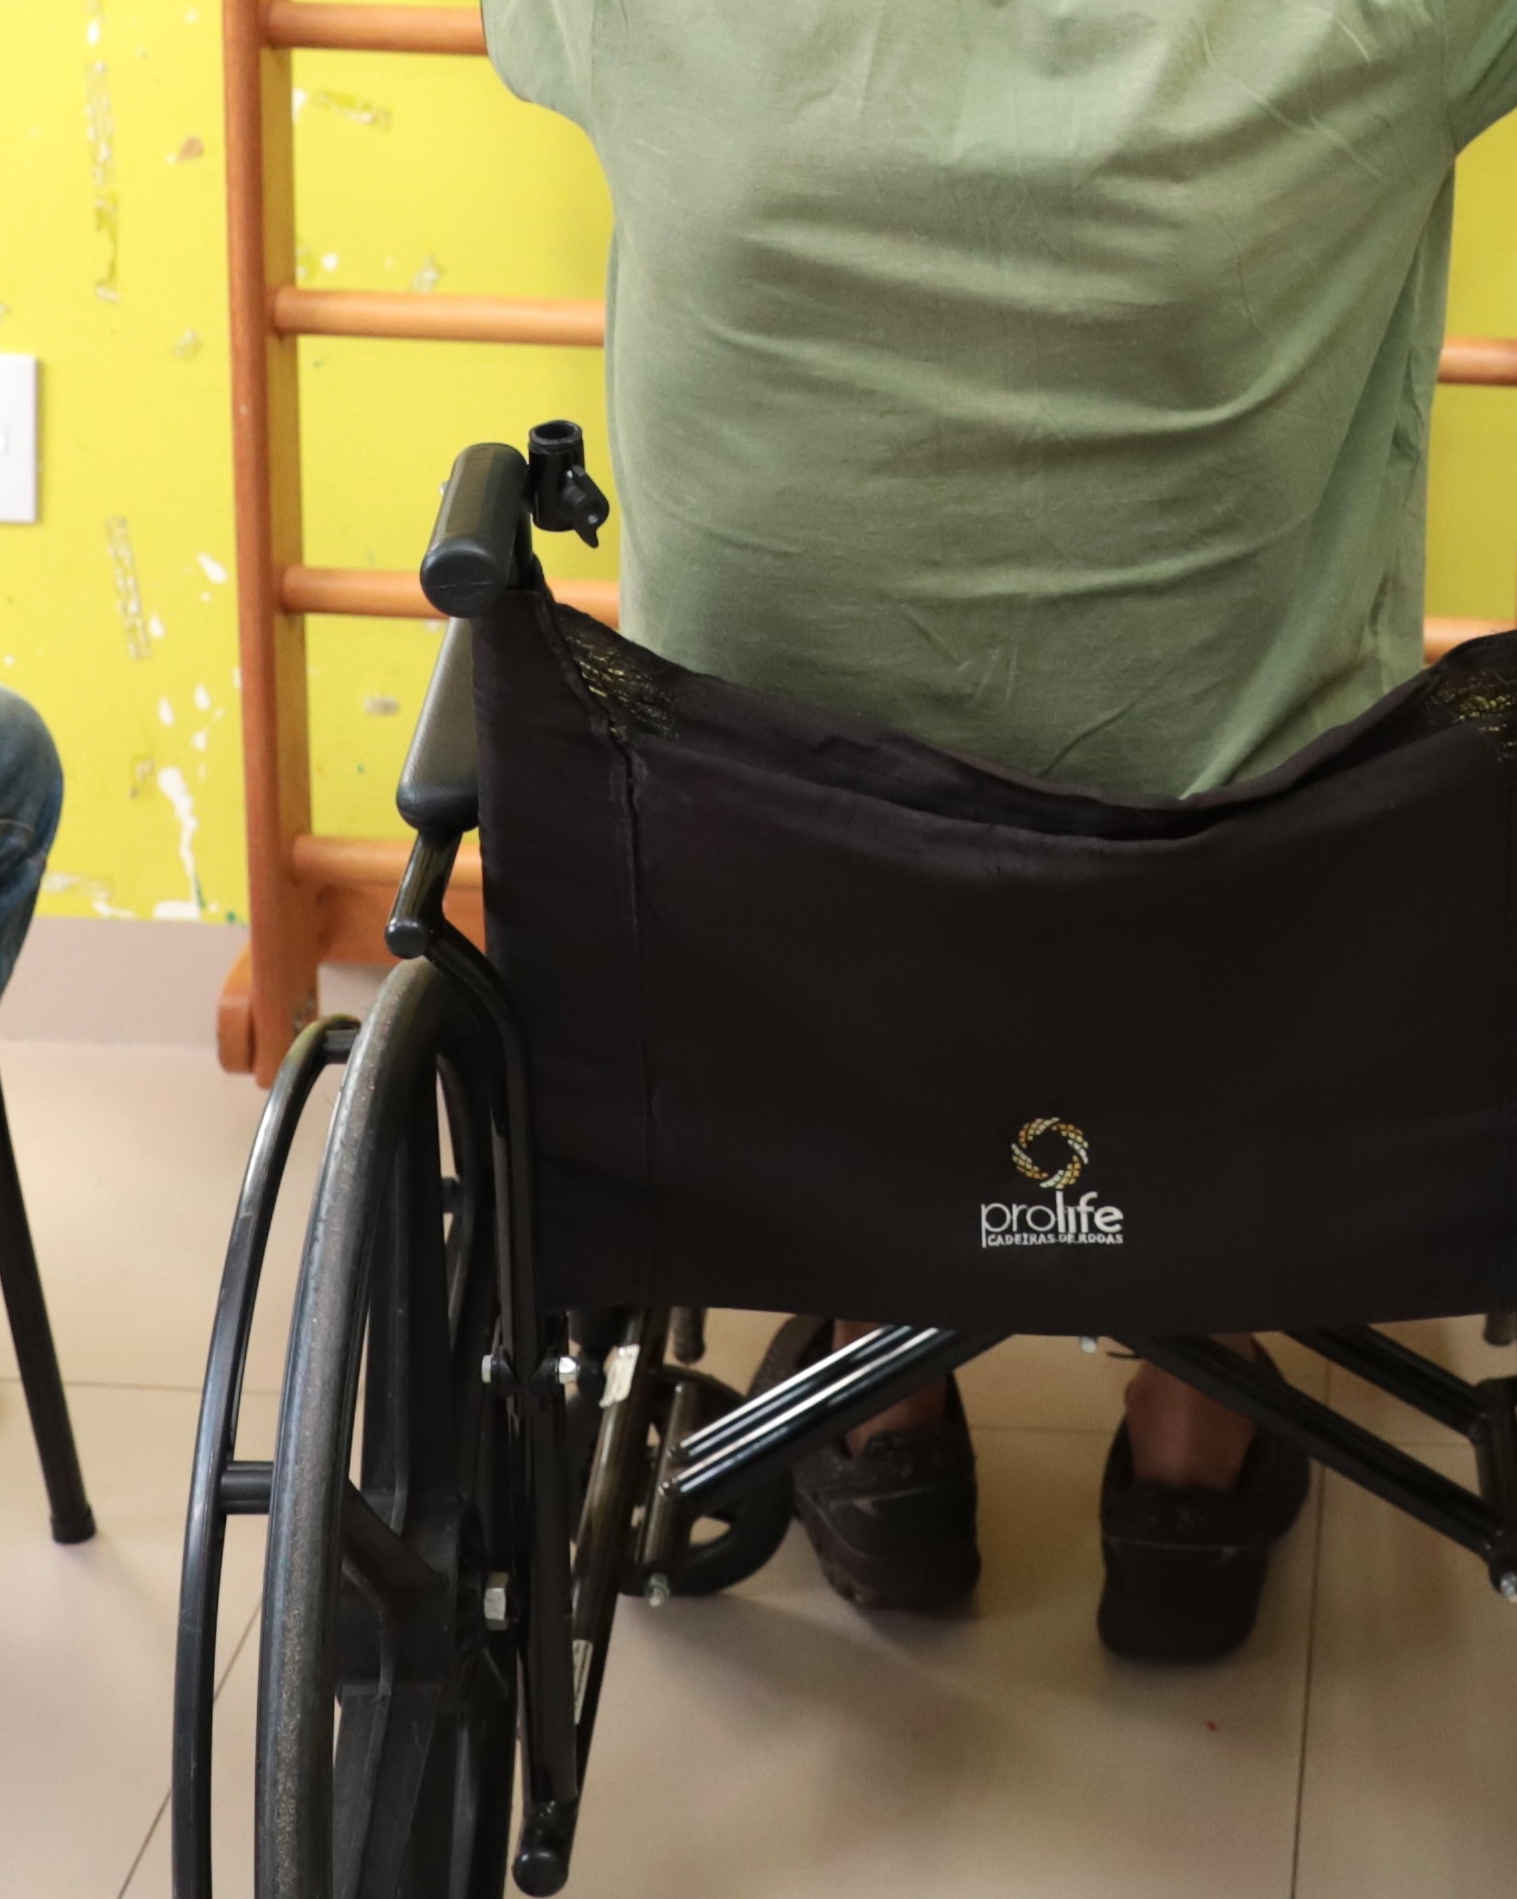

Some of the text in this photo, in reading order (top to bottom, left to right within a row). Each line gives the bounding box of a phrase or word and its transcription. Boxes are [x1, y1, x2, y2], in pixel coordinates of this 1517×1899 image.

[981, 1190, 1124, 1248] prolife
[987, 1232, 1124, 1247] CADEIRAS DE RODAS
